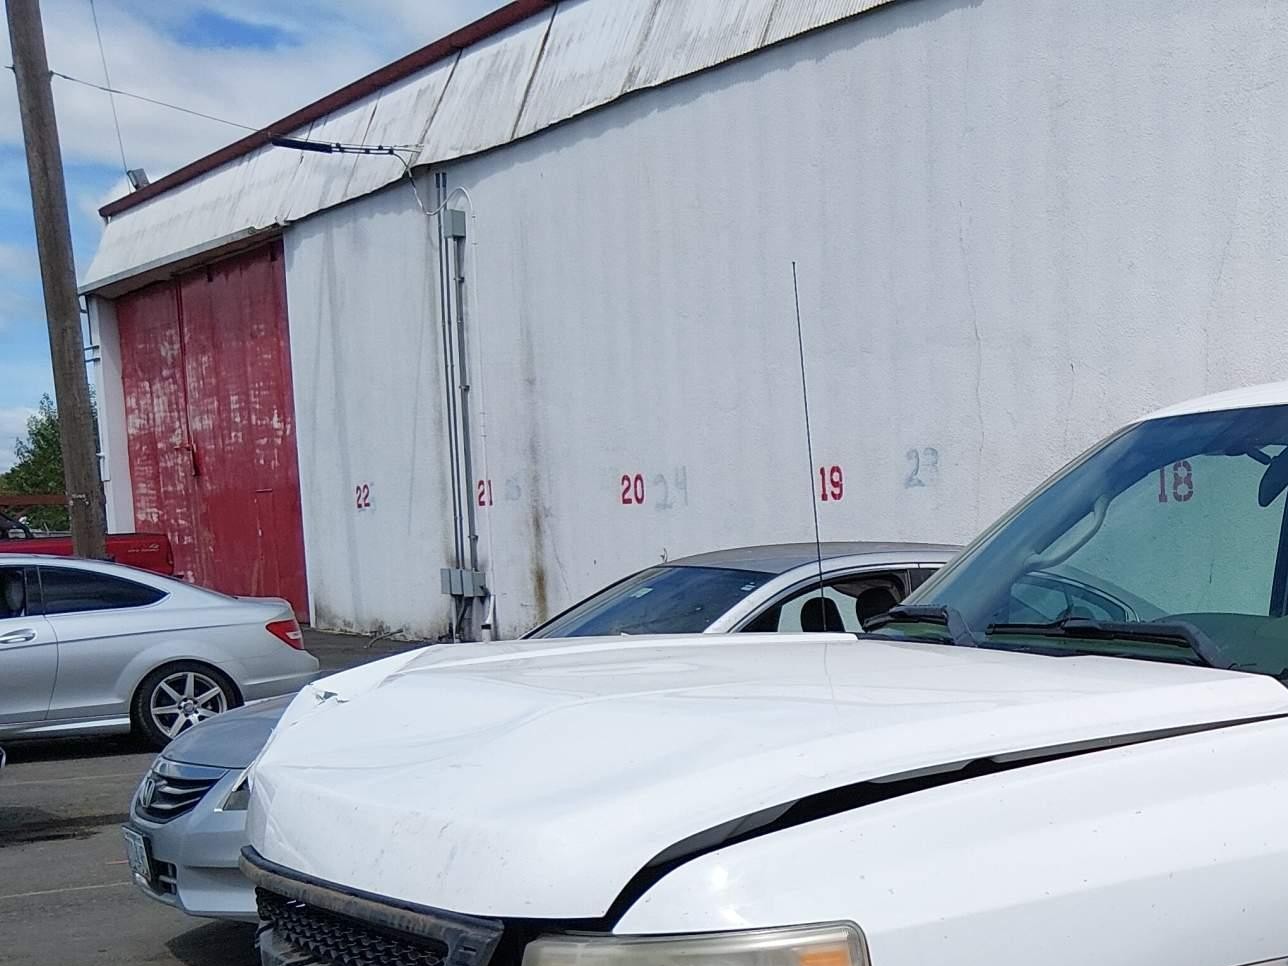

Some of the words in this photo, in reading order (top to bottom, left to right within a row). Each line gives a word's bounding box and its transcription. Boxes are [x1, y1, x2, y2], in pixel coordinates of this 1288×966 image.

[356, 484, 371, 508] 22
[477, 480, 493, 507] 21
[621, 474, 645, 505] 20
[819, 465, 843, 501] 19
[1158, 460, 1194, 503] 18
